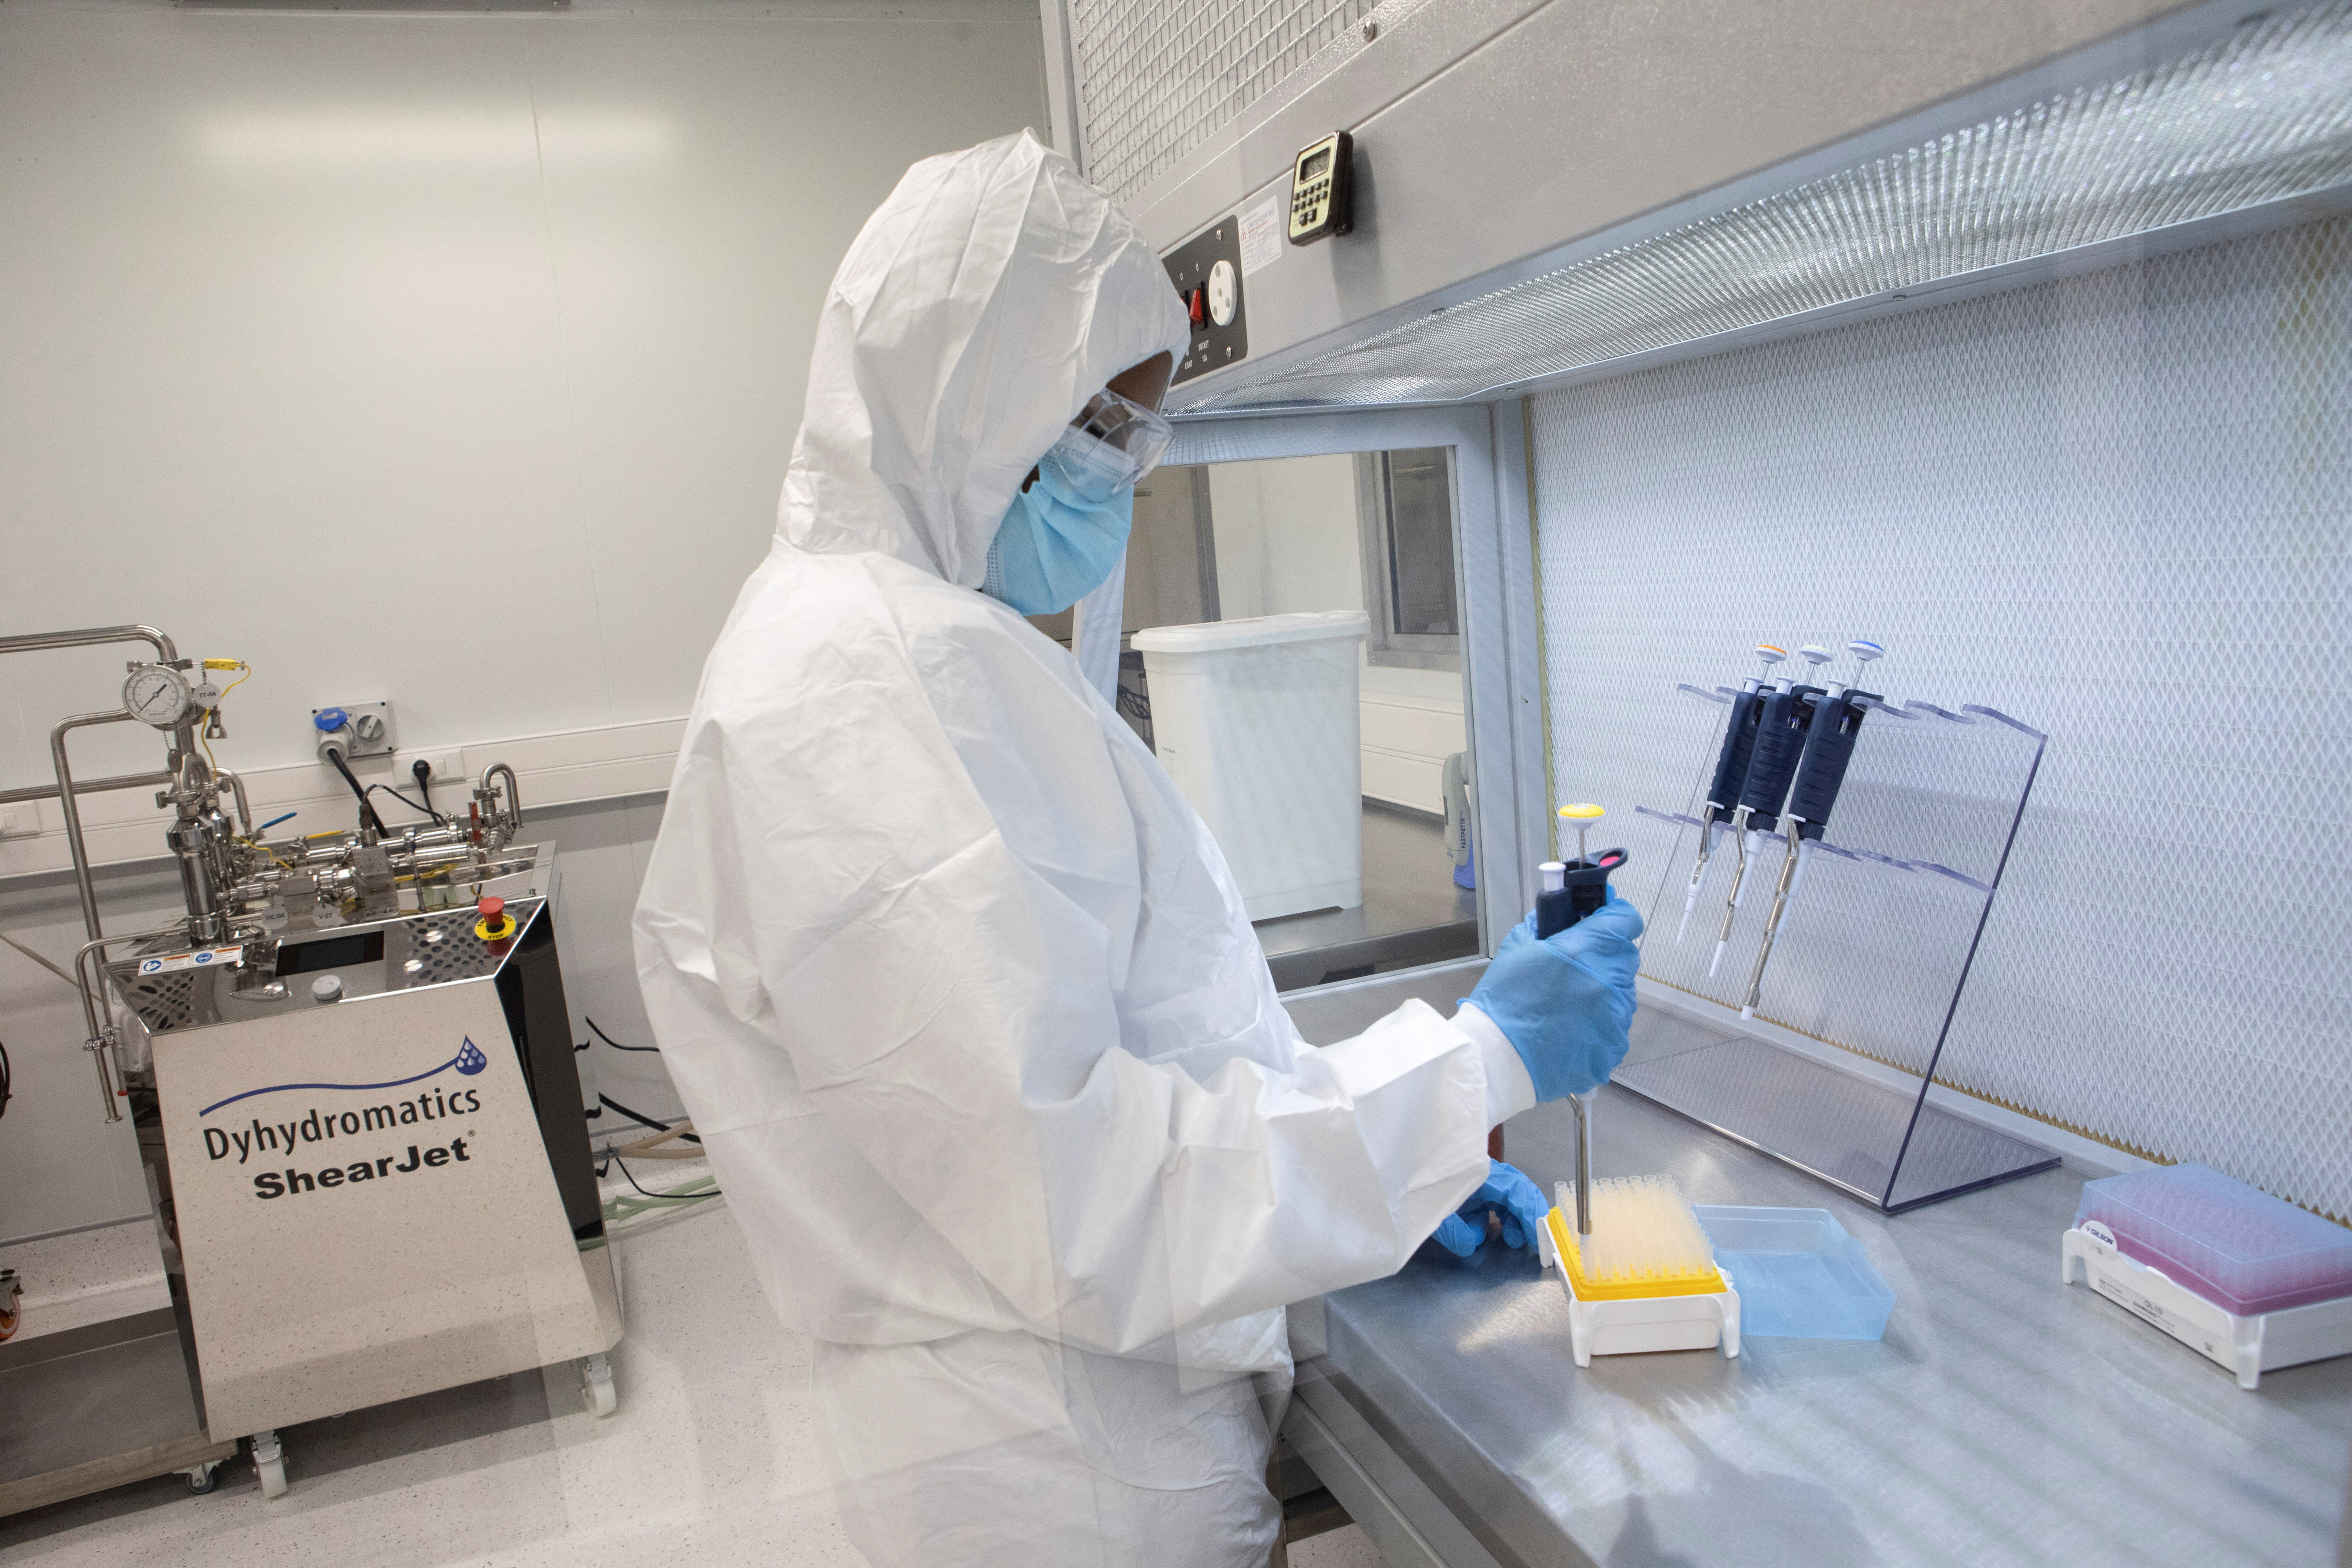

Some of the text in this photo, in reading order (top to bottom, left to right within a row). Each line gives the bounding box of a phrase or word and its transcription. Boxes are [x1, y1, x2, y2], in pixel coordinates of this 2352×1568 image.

[1198, 340, 1209, 351] SOCKET
[203, 1087, 481, 1164] Dyhydromatics
[2091, 1229, 2113, 1245] GILSON
